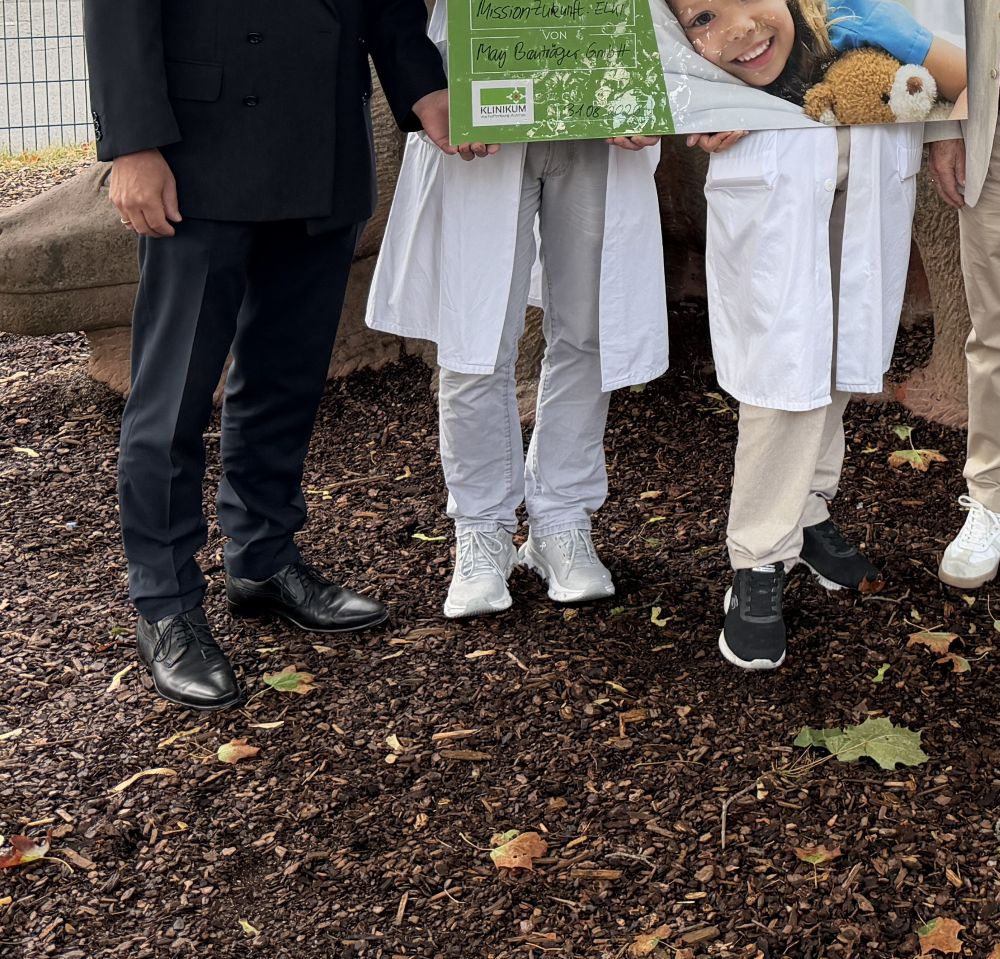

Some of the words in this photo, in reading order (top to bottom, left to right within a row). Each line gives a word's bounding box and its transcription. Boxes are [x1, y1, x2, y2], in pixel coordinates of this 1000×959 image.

[542, 31, 567, 39] VON
[476, 43, 506, 68] May
[480, 105, 526, 114] KLINIKUM
